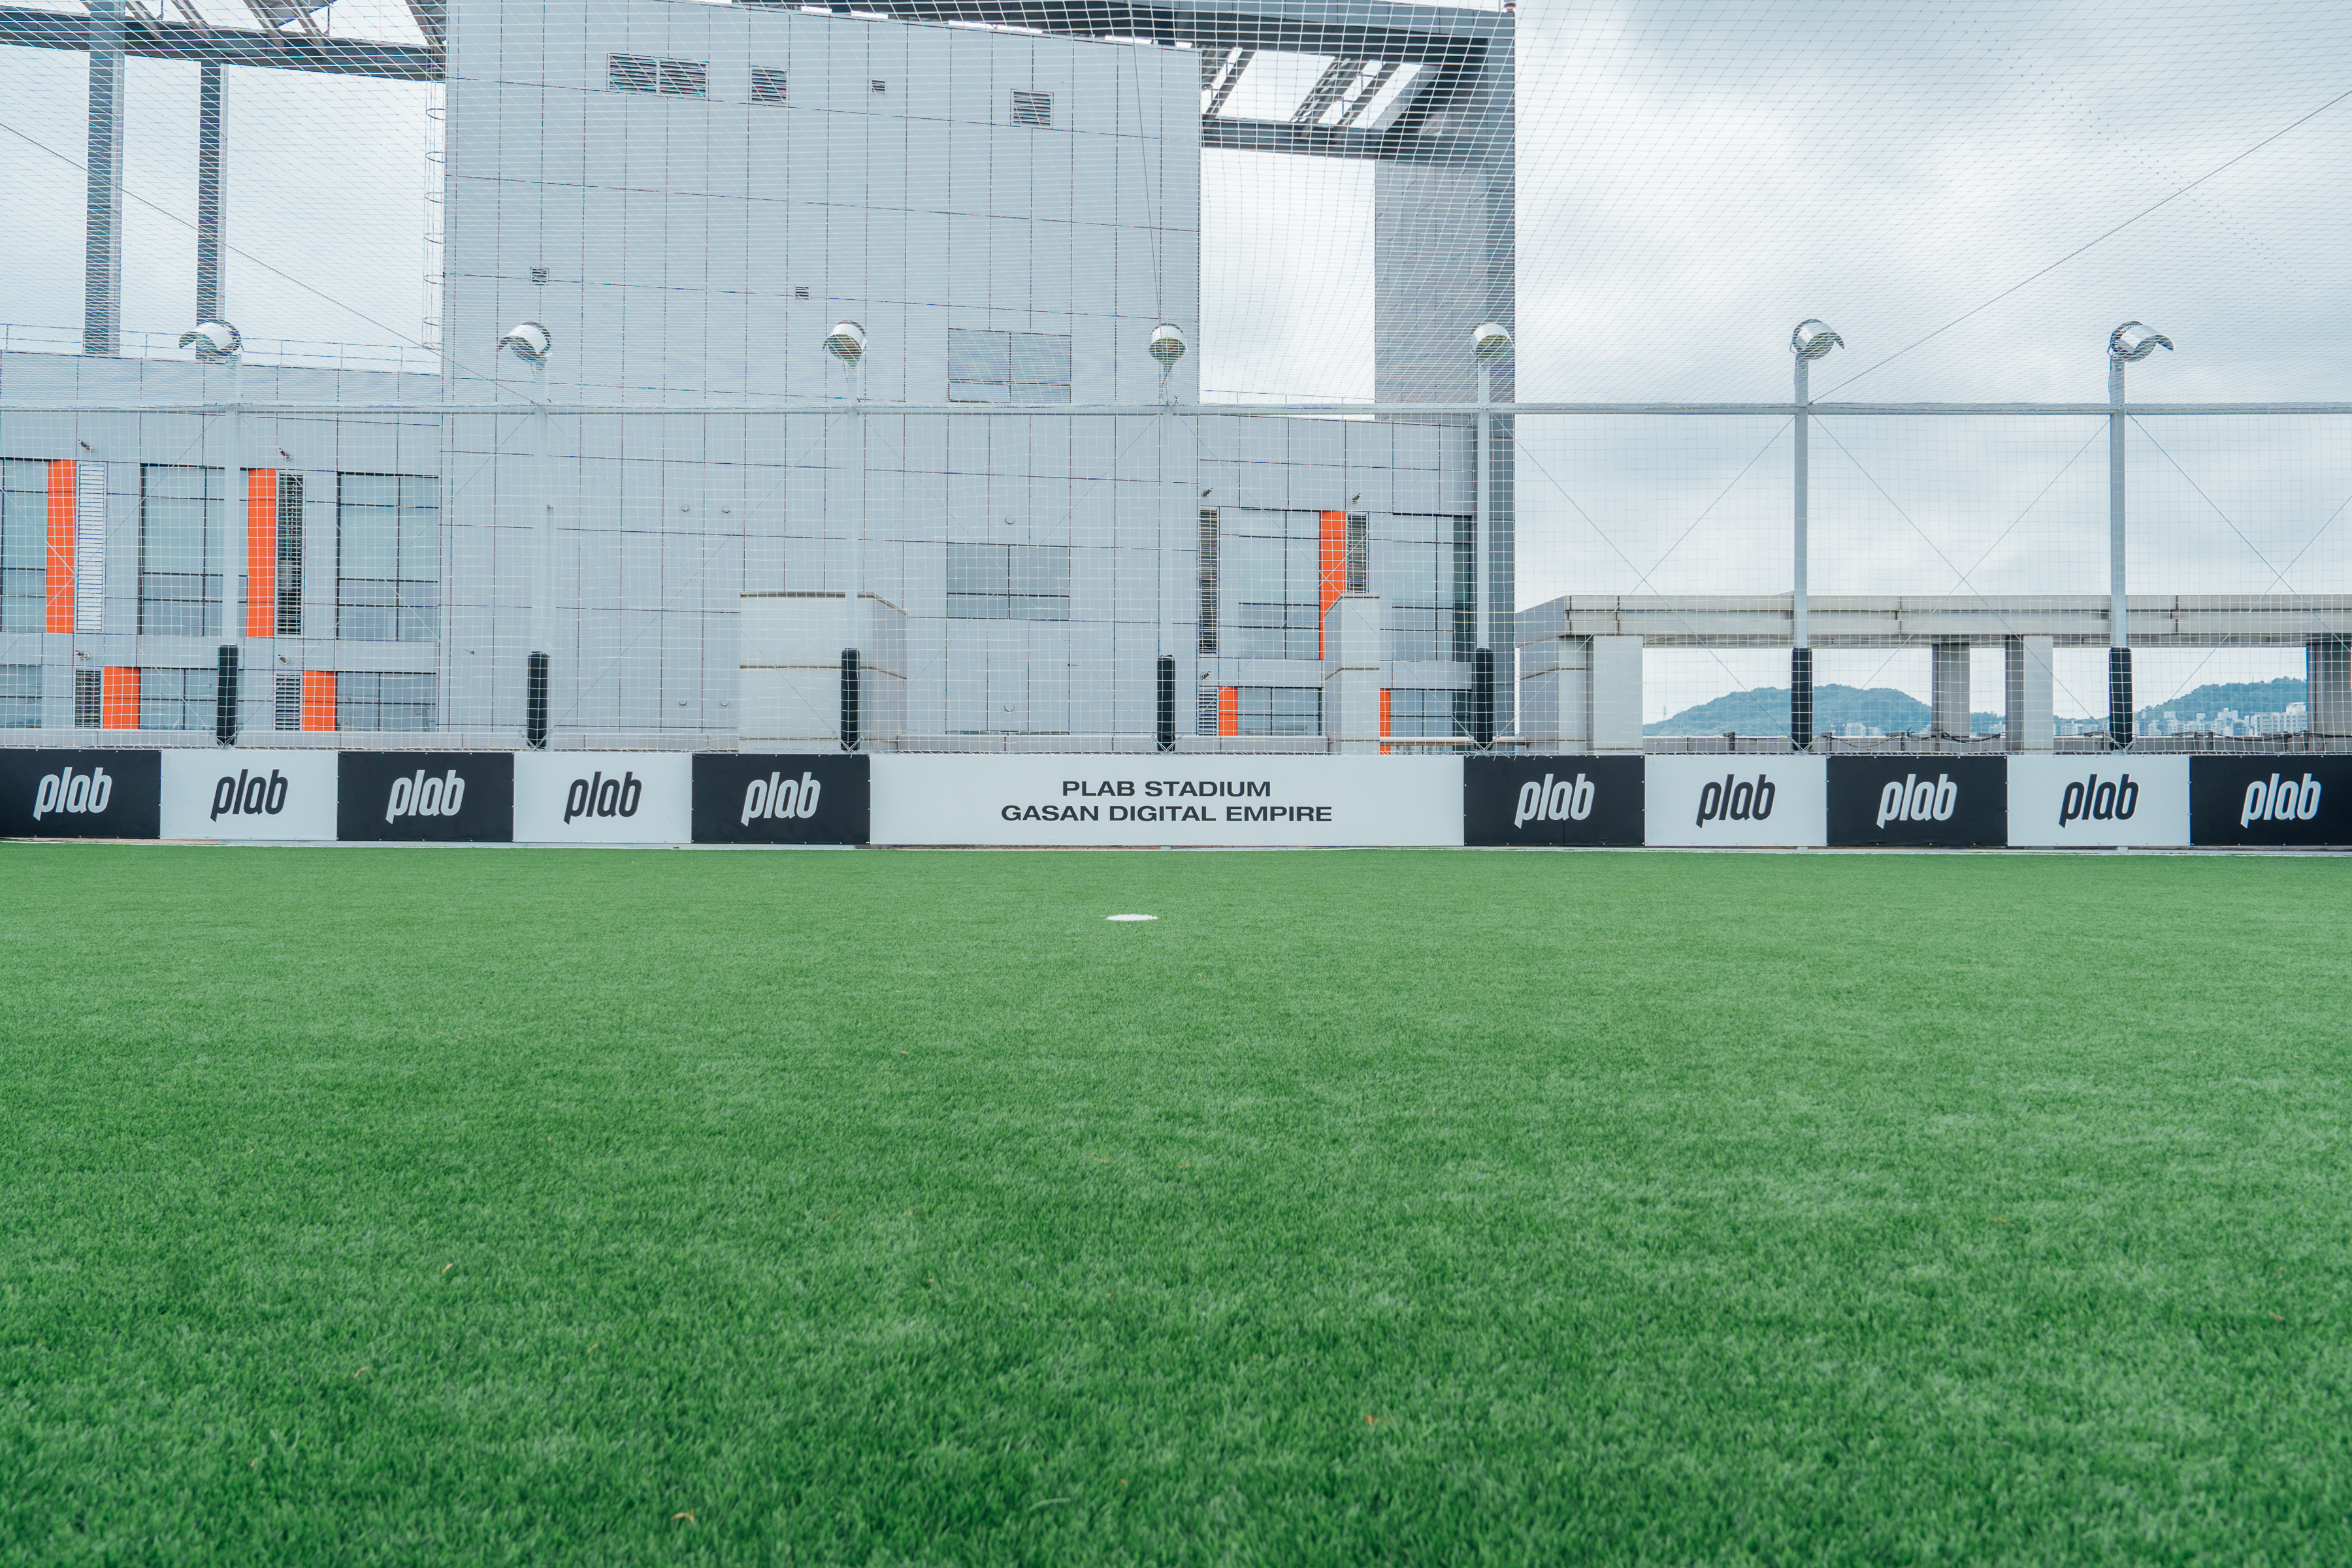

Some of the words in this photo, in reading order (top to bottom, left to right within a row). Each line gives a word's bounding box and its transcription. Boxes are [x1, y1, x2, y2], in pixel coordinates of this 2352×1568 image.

[33, 766, 112, 821] plab
[210, 768, 288, 823] plab
[385, 769, 465, 825] plab
[563, 771, 642, 825] plab
[740, 772, 821, 827] plab
[1001, 805, 1099, 821] GASAN
[1109, 806, 1217, 822] DIGITAL
[1226, 806, 1332, 822] EMPIRE
[1062, 781, 1135, 796] PLAB
[1145, 781, 1271, 797] STADIUM
[1514, 773, 1595, 829] plab
[1695, 774, 1776, 828] plab
[1876, 774, 1957, 829] plab
[2058, 774, 2139, 828] plab
[2240, 773, 2321, 828] plab
